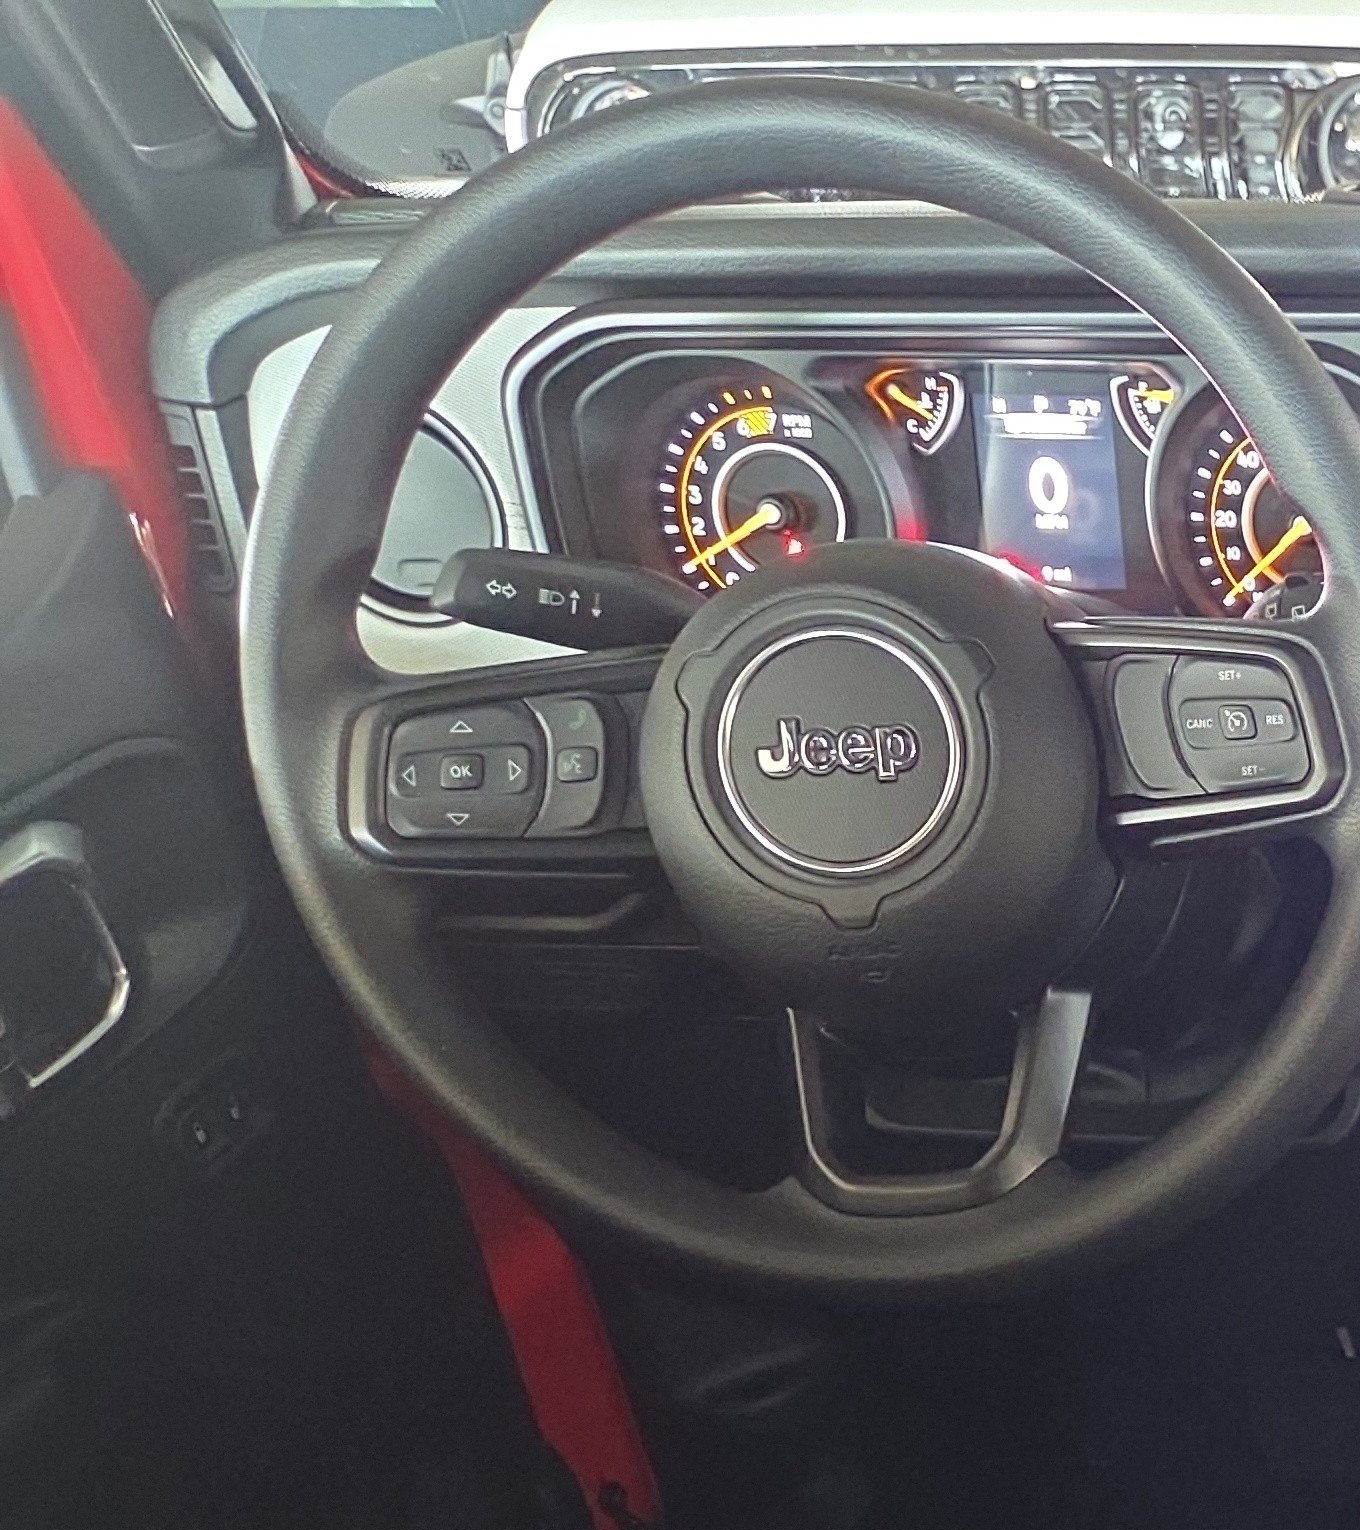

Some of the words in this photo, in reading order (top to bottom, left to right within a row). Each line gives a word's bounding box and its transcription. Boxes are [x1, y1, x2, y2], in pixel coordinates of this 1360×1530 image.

[906, 418, 919, 433] C
[711, 431, 727, 451] 5
[694, 455, 709, 475] 4
[1236, 450, 1261, 469] 40
[1028, 456, 1069, 514] 0
[1223, 480, 1242, 496] 30
[687, 485, 703, 505] 3
[691, 516, 707, 537] 2
[1214, 509, 1238, 528] 20
[1227, 546, 1241, 561] 10
[1218, 670, 1242, 681] SET+
[1186, 719, 1213, 730] CANC
[1265, 715, 1284, 725] RES
[756, 715, 920, 783] Jeep
[450, 764, 474, 779] OK
